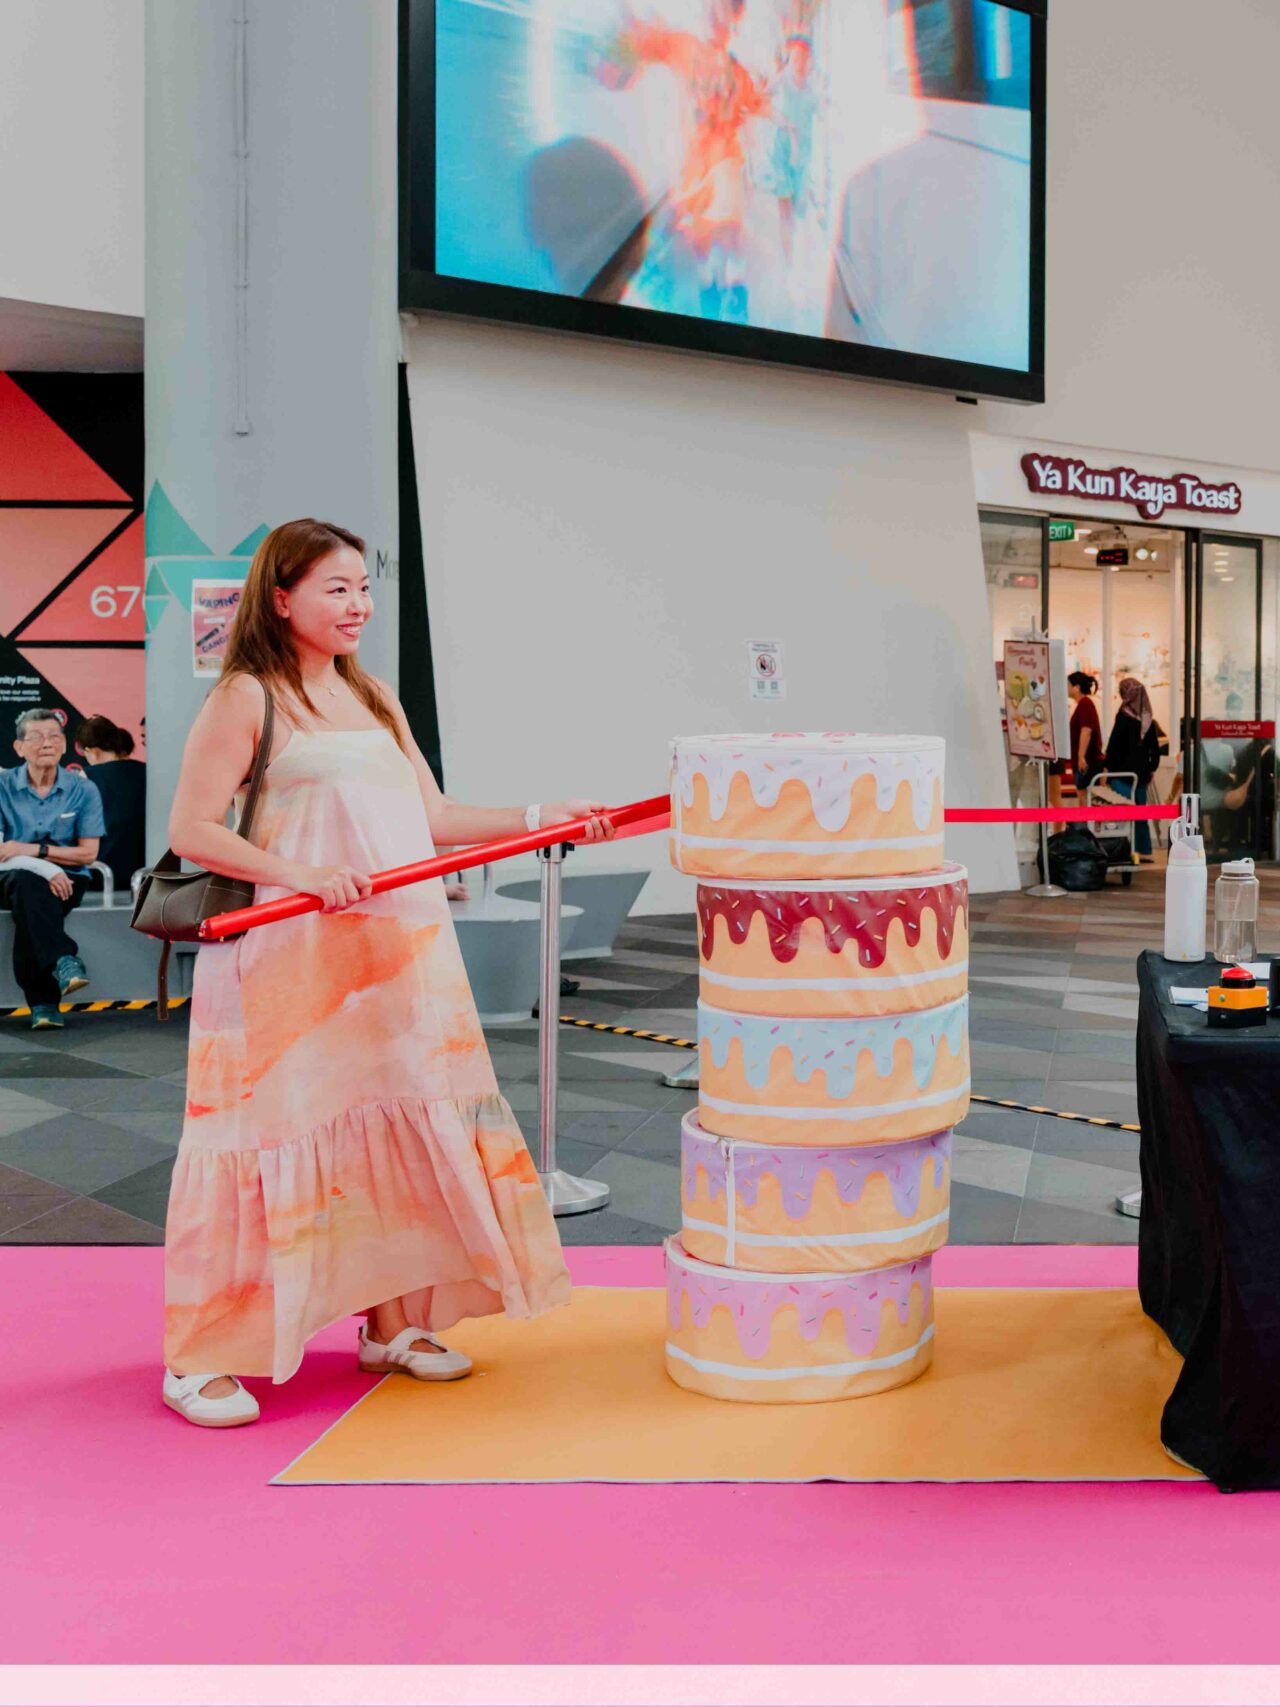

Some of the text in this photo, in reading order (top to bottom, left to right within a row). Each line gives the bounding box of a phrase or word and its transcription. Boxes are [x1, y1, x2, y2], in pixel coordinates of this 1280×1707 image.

[1033, 459, 1240, 515] Ya Kun Kaya Toast
[1049, 525, 1067, 539] EXIT
[90, 585, 145, 618] 67
[17, 675, 40, 685] Plaza
